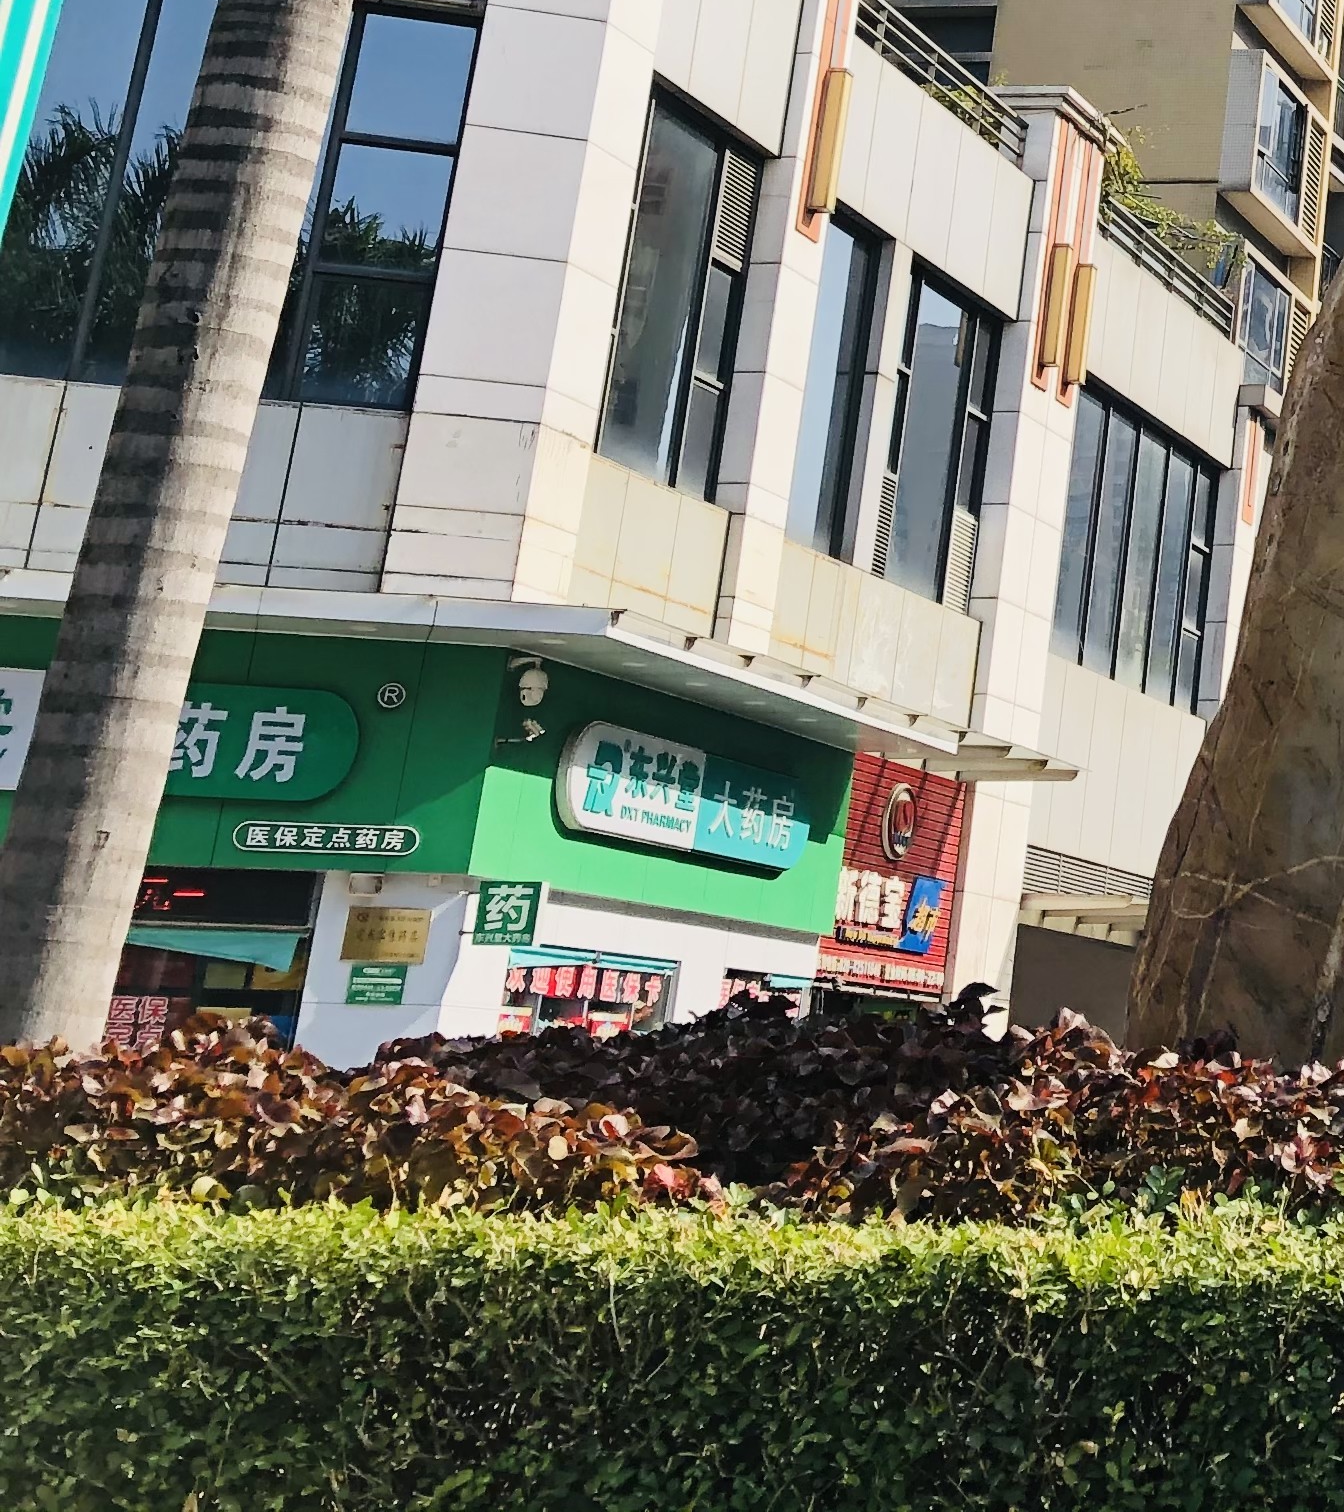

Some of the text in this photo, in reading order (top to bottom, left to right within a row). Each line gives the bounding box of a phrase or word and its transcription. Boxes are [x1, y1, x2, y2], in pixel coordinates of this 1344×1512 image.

[620, 804, 693, 835] DXT PHARMACY
[245, 825, 406, 852] 医保定点药房
[484, 884, 534, 931] 药
[106, 995, 169, 1024] 医保
